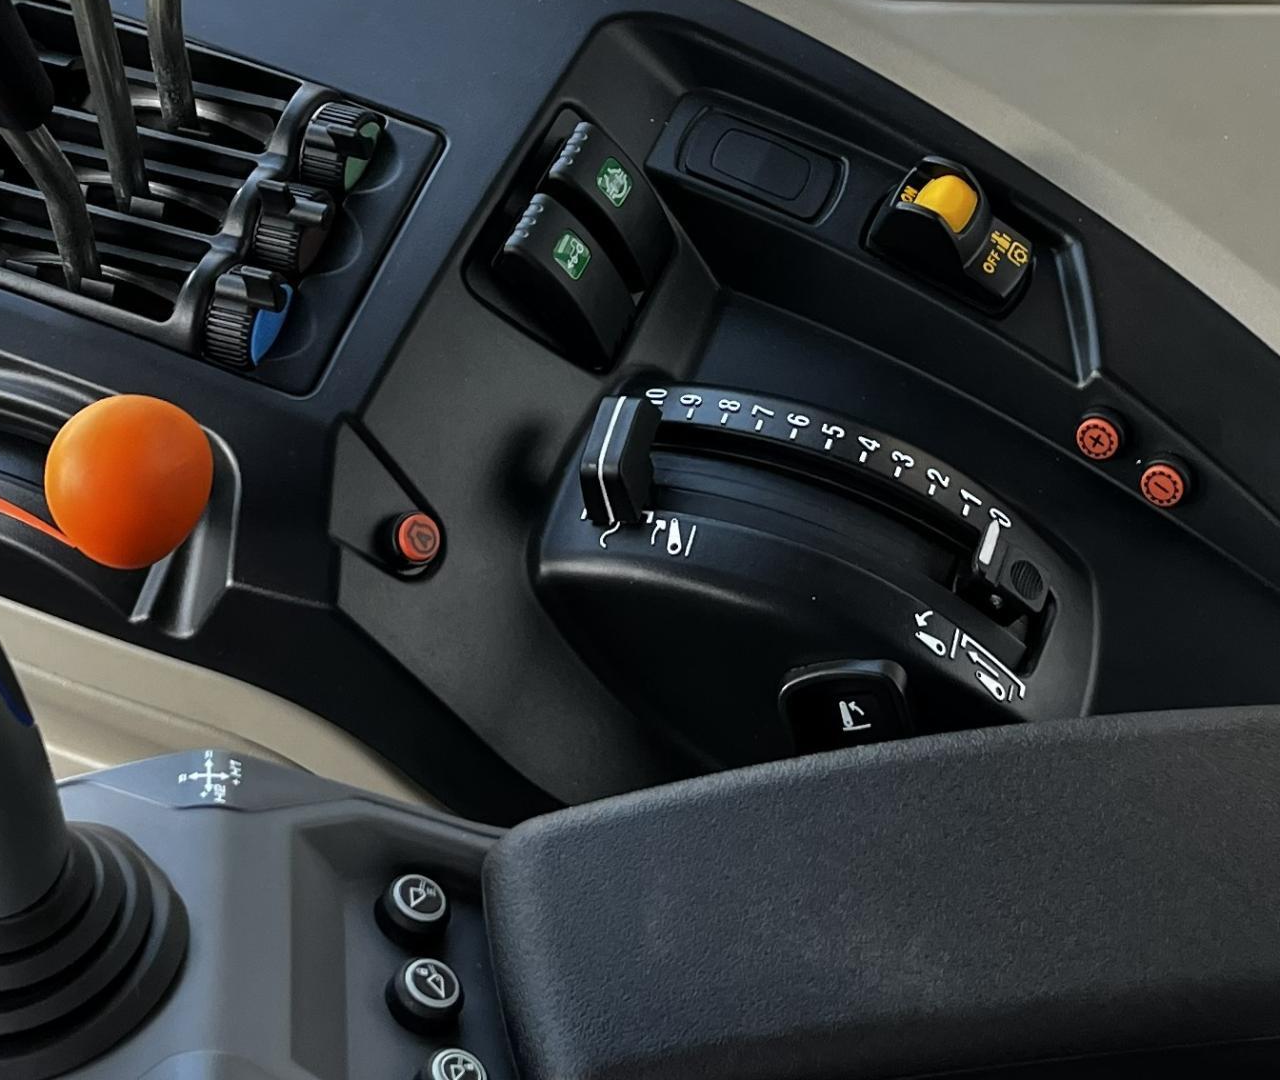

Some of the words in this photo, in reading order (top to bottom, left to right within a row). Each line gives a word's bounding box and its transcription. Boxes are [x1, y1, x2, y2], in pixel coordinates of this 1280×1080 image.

[982, 249, 1001, 274] OFF
[645, 388, 668, 406] 10
[680, 393, 703, 407] 9
[718, 398, 741, 412] 8
[751, 404, 775, 417] 7
[786, 412, 811, 427] 6
[821, 423, 846, 438] 5
[857, 435, 881, 452] 4
[891, 450, 915, 468] 3
[926, 468, 950, 488] 2
[960, 488, 983, 506] 1
